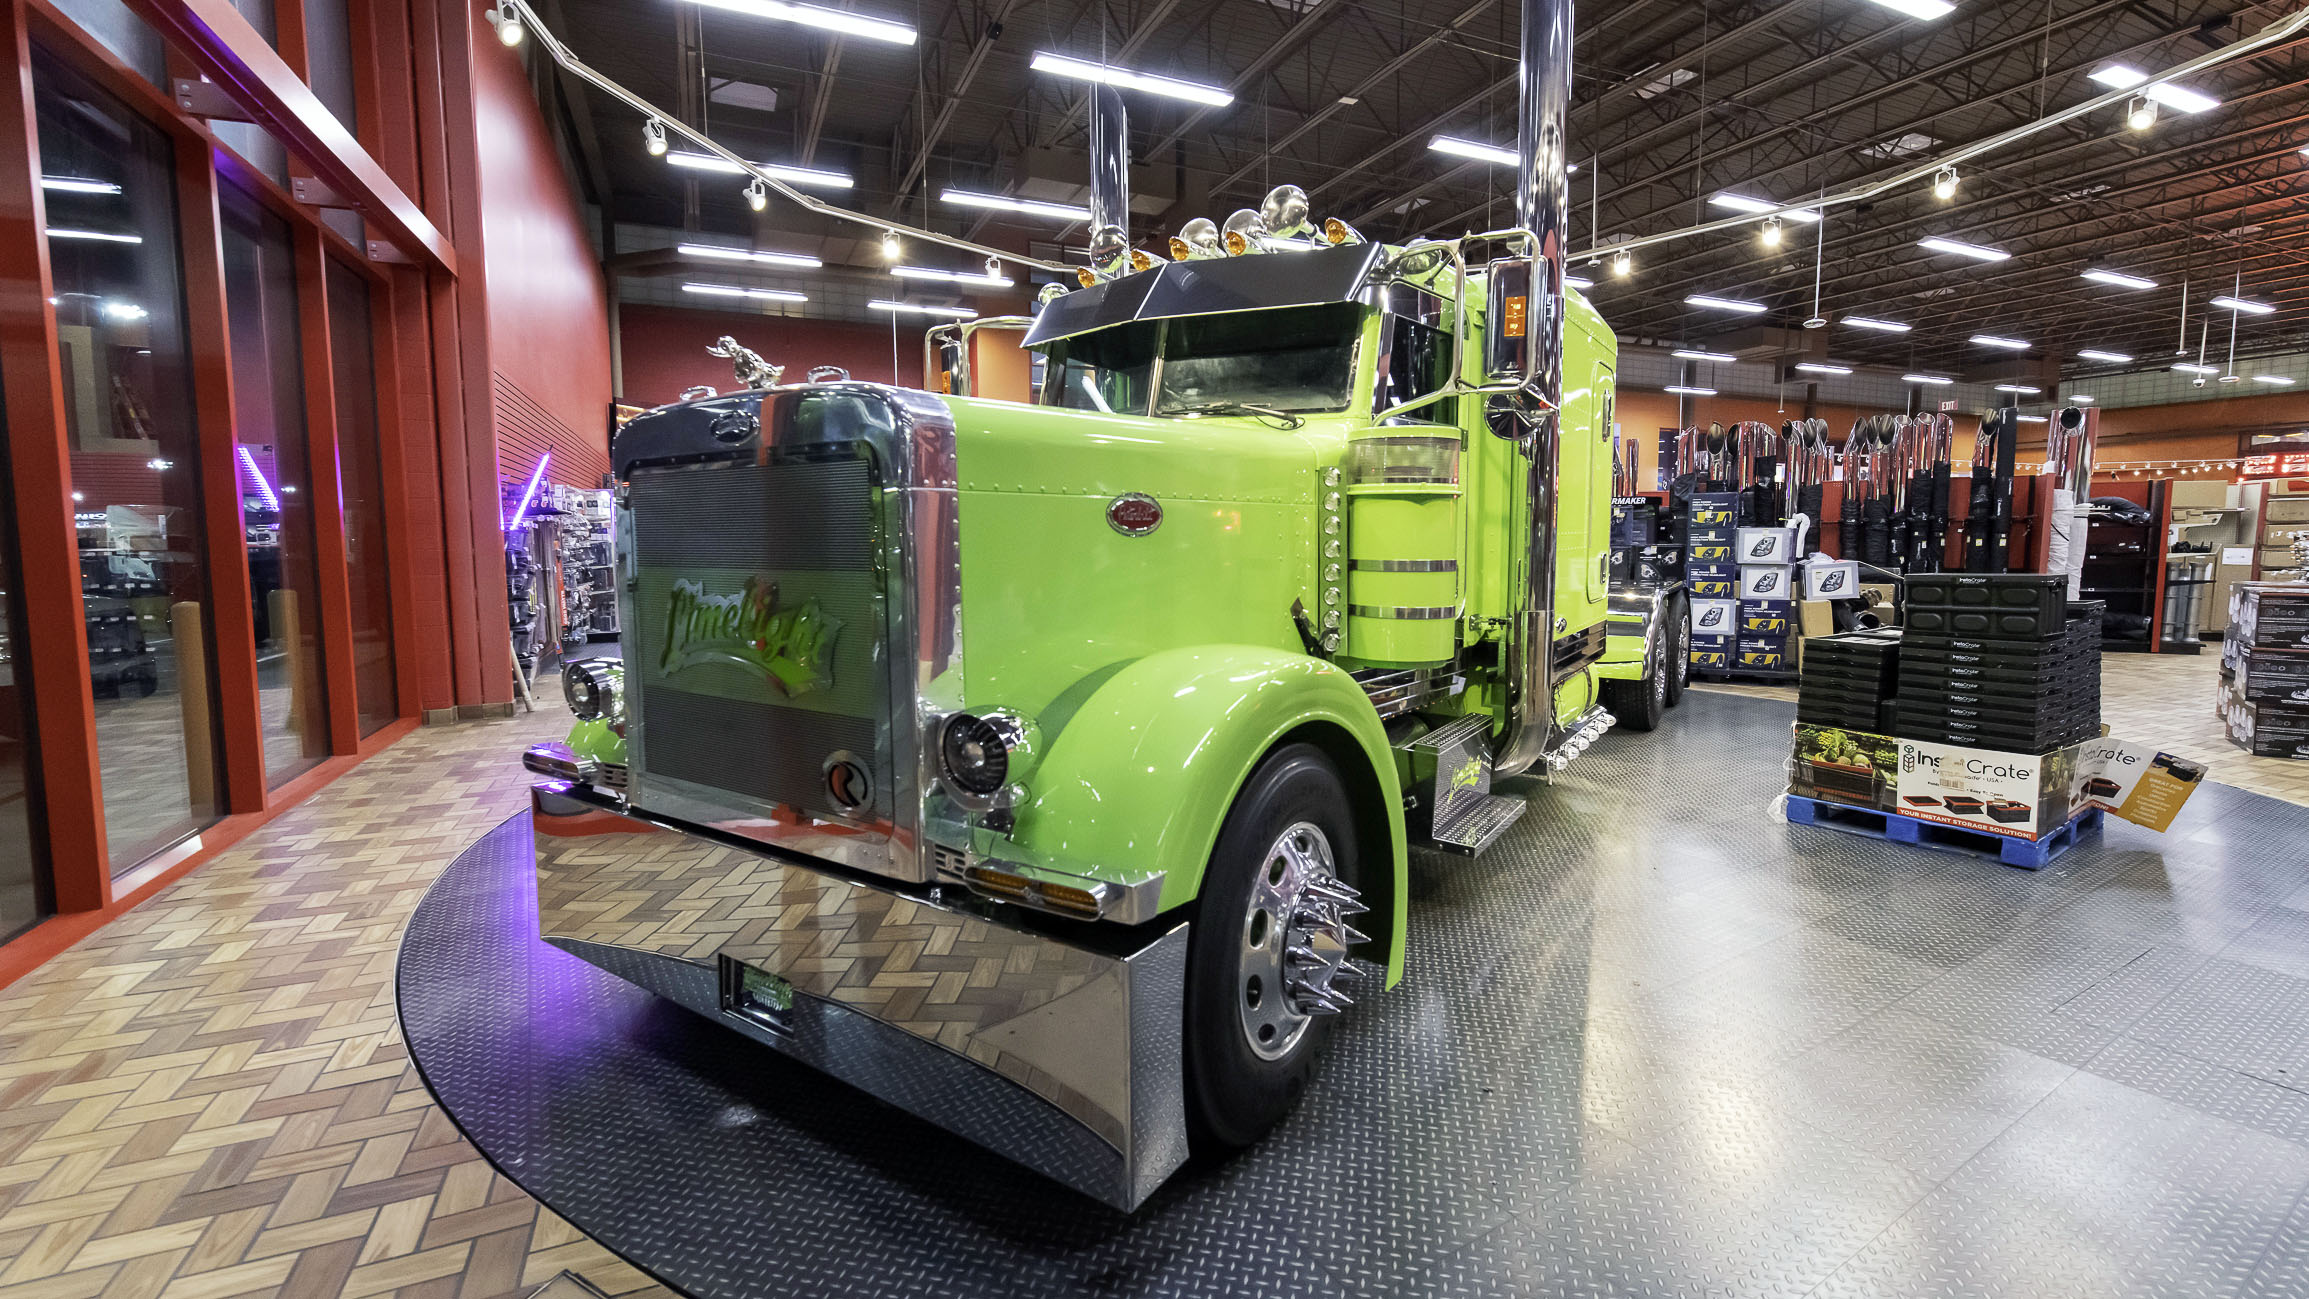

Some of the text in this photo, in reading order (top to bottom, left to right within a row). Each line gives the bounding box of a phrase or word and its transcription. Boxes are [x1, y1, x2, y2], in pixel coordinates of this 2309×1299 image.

[1942, 401, 1955, 410] EXIT
[1918, 750, 2030, 780] InsCrate
[1900, 808, 2032, 839] YOUR INSTANT STORAGE SOLUTION!
